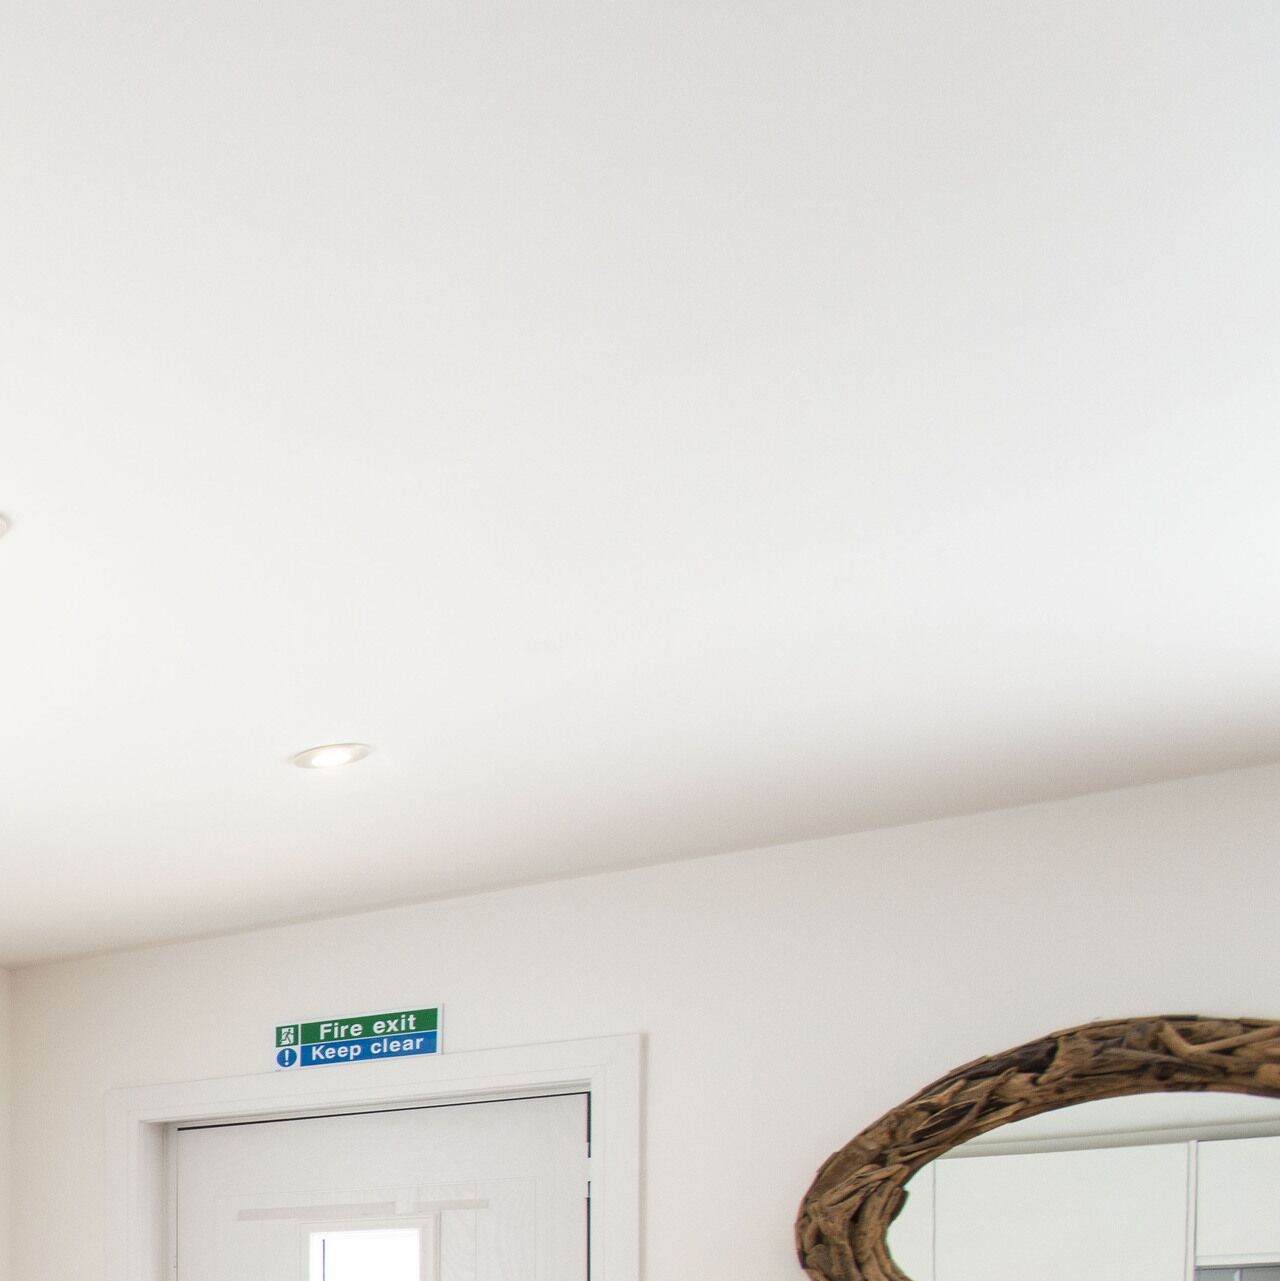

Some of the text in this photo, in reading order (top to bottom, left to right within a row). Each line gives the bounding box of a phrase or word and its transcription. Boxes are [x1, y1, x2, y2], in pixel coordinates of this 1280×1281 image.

[319, 1014, 417, 1040] Fire exit
[311, 1037, 424, 1061] Keep clear
